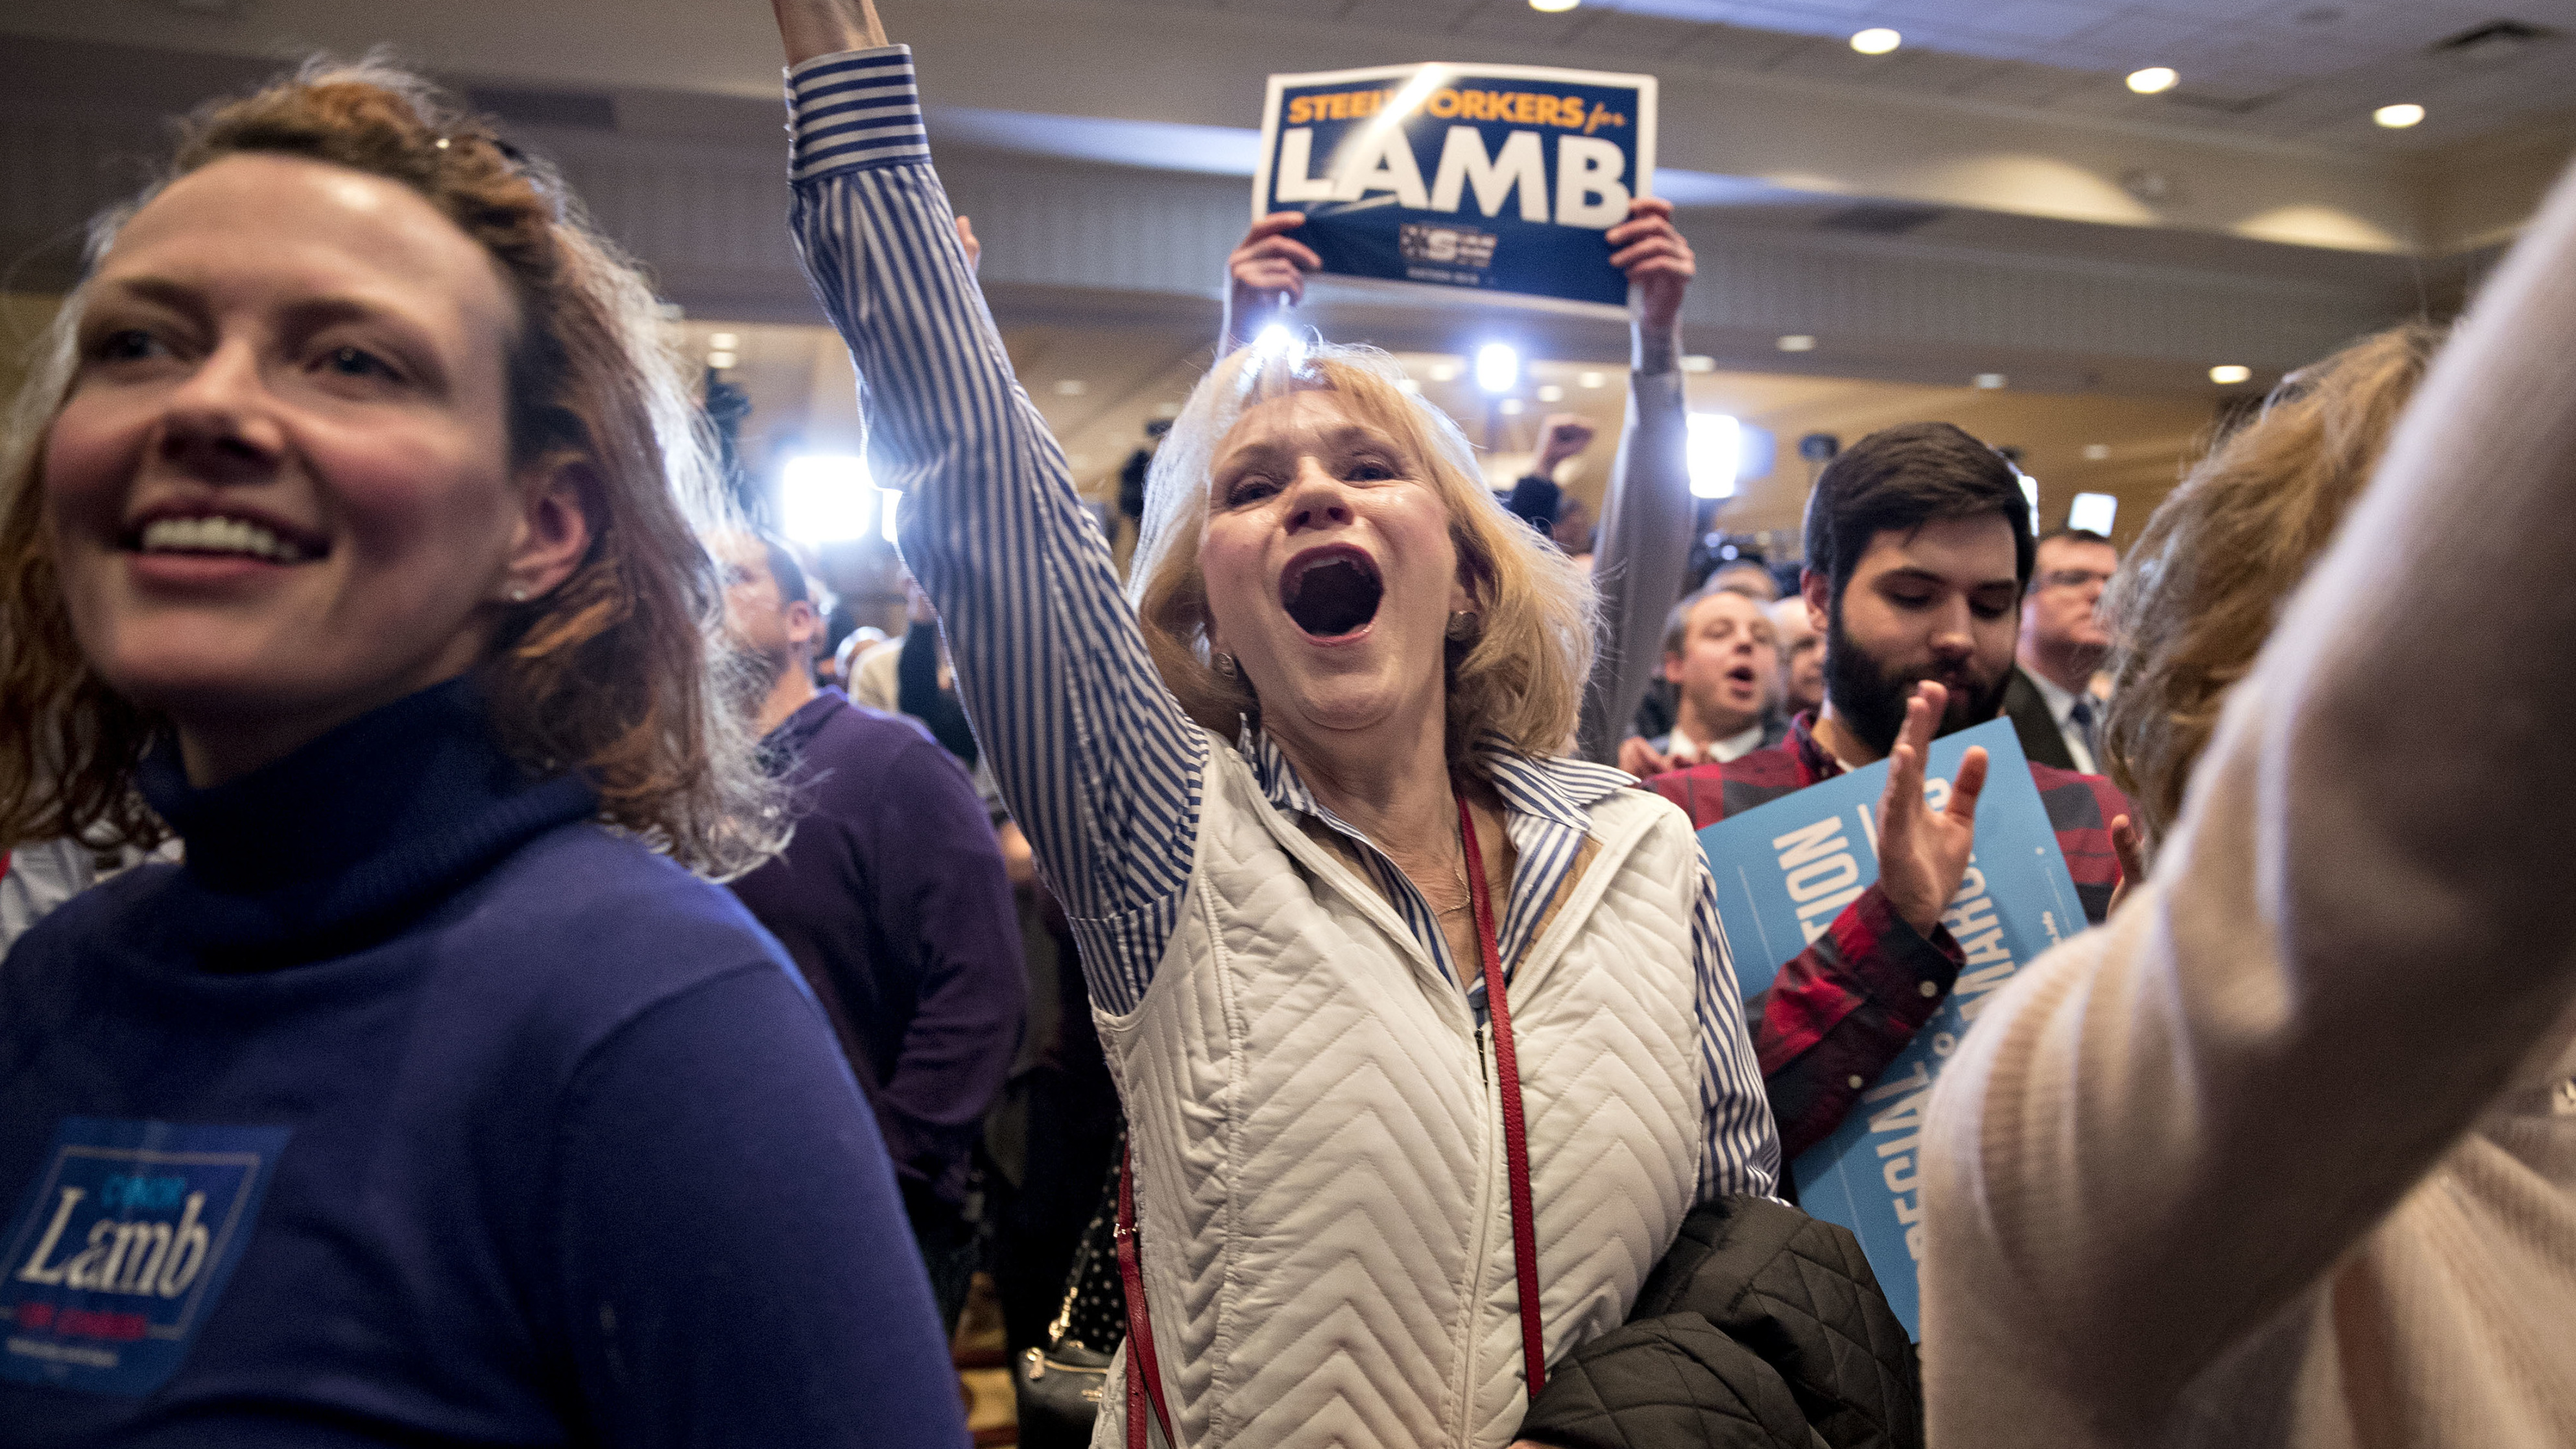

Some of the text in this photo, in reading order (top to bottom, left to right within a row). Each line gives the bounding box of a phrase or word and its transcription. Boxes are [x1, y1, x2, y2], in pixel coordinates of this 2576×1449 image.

[1288, 88, 1586, 128] STEELORKERS
[1275, 126, 1631, 230] LAMB
[1861, 1060, 1935, 1261] CIAL
[17, 1186, 209, 1299] Lamb
